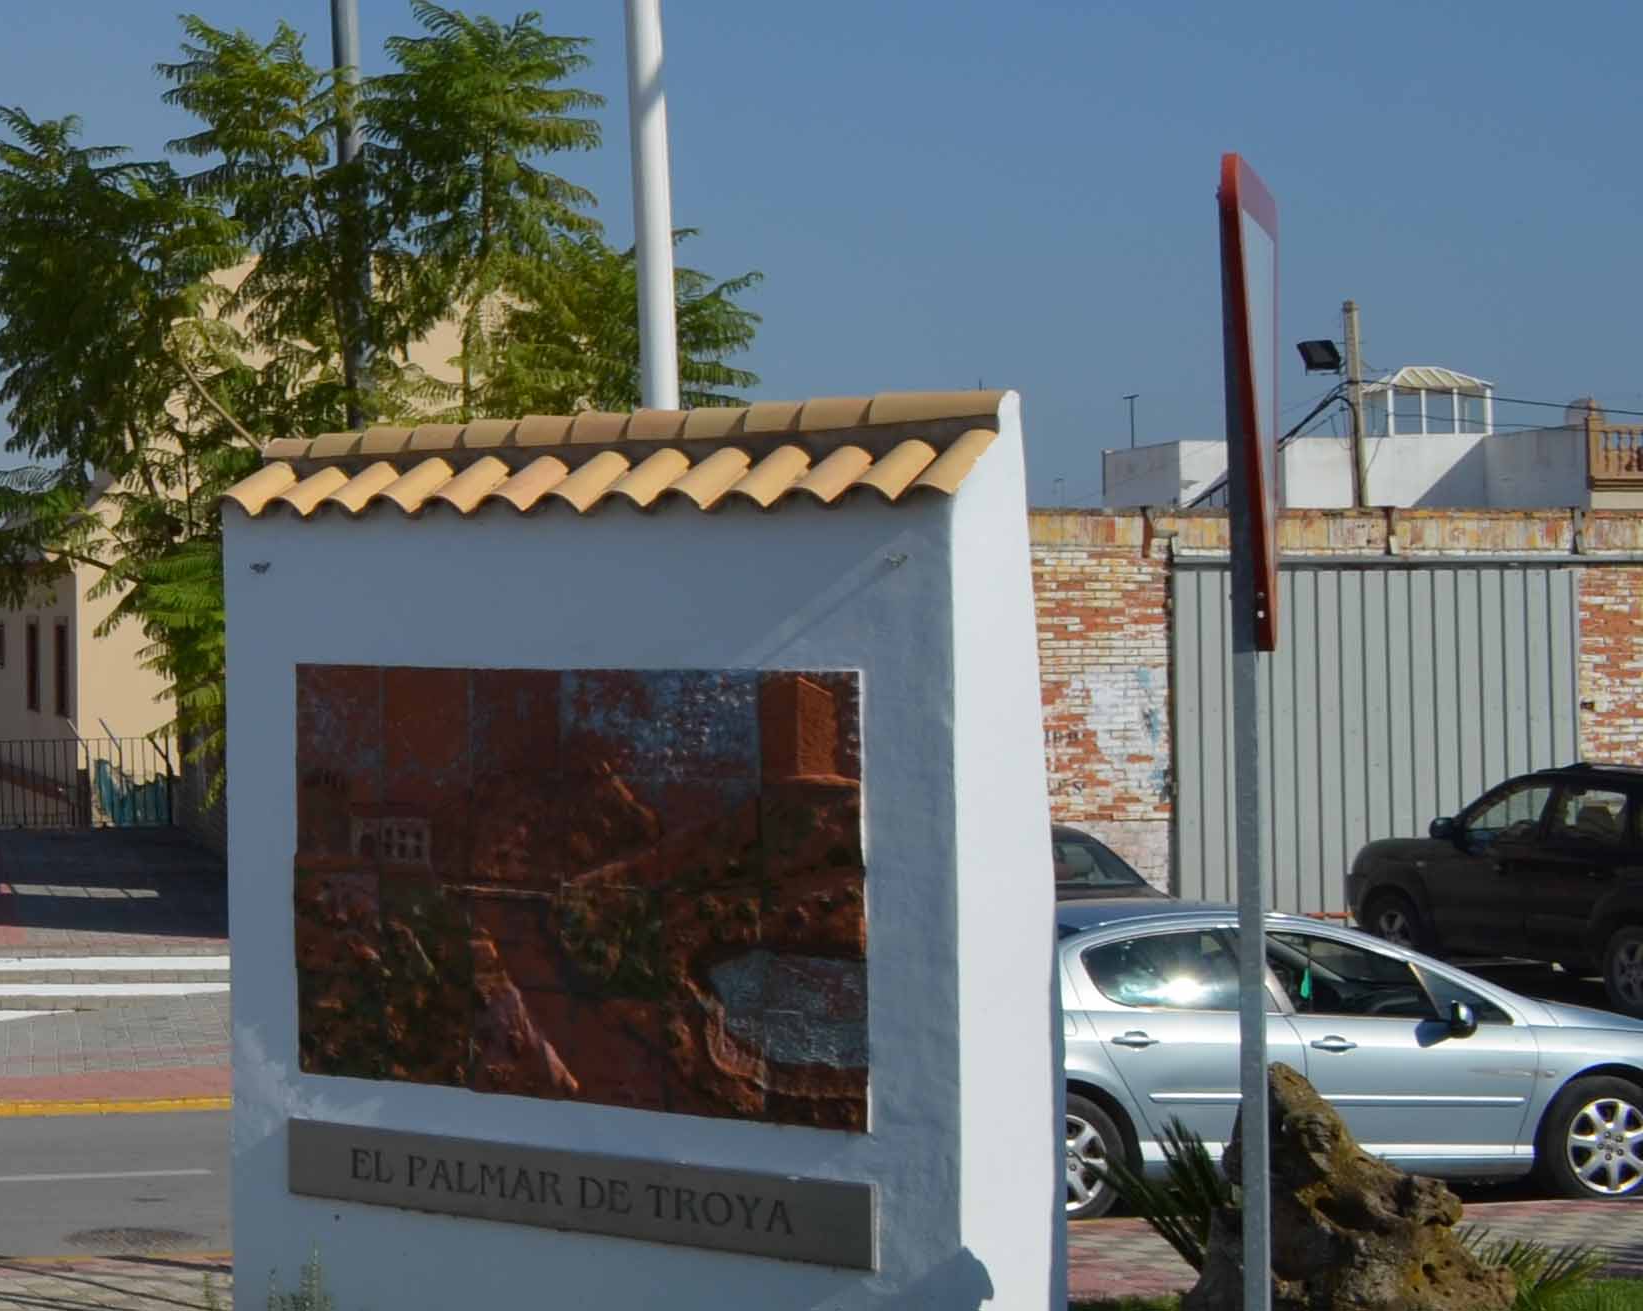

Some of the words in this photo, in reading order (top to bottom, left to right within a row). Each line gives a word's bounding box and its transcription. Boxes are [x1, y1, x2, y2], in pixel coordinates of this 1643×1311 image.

[350, 1147, 395, 1184] EL
[405, 1154, 564, 1207] PALMAR
[578, 1175, 635, 1216] DE
[645, 1183, 795, 1237] TROYA
